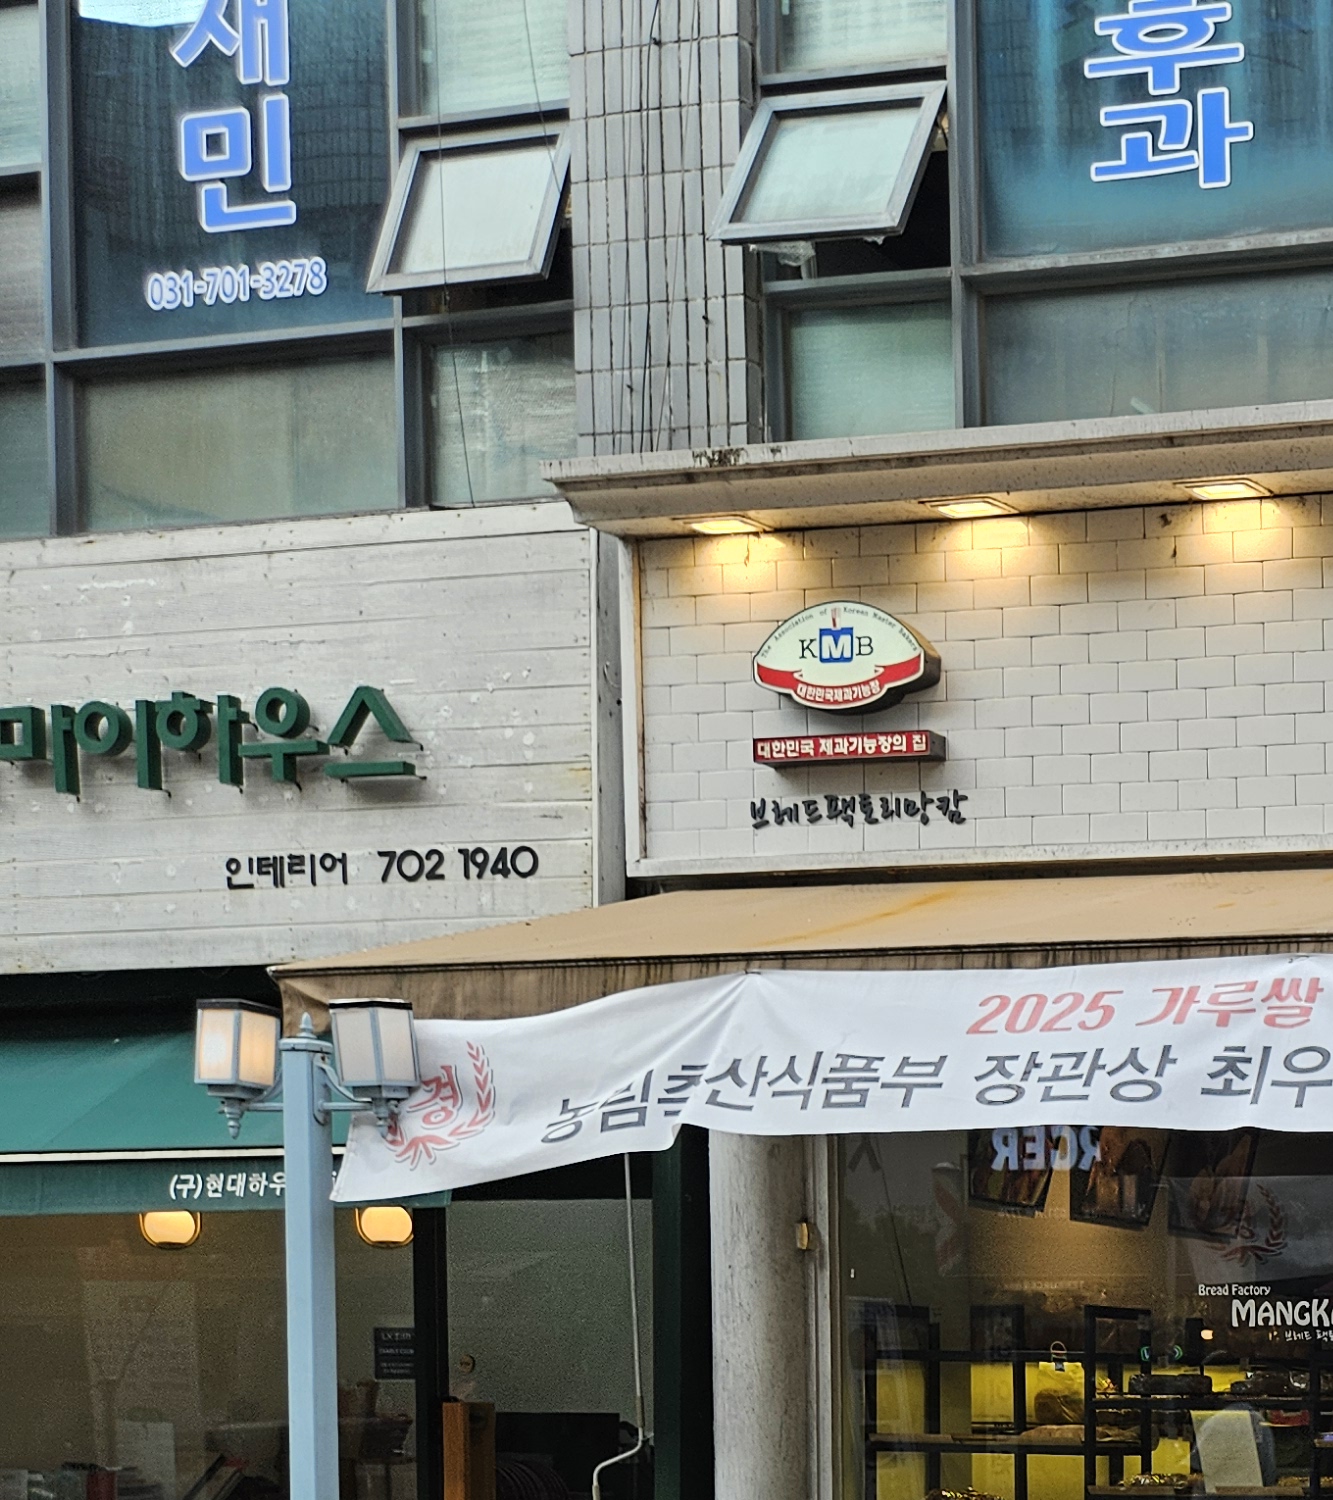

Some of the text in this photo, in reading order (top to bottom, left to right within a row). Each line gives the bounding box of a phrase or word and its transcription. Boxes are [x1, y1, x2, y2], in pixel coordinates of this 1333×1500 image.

[146, 257, 327, 311] 031-701-3278
[757, 733, 927, 759] 대한민국 제과기능장의 집
[226, 845, 540, 890] 인테리어 702 1940
[966, 990, 1123, 1035] 2025
[1135, 977, 1325, 1030] 가루쌀
[972, 1045, 1177, 1107] 장관상
[169, 1171, 286, 1200] (구)현대하우
[1197, 1284, 1271, 1297] Bread Factory
